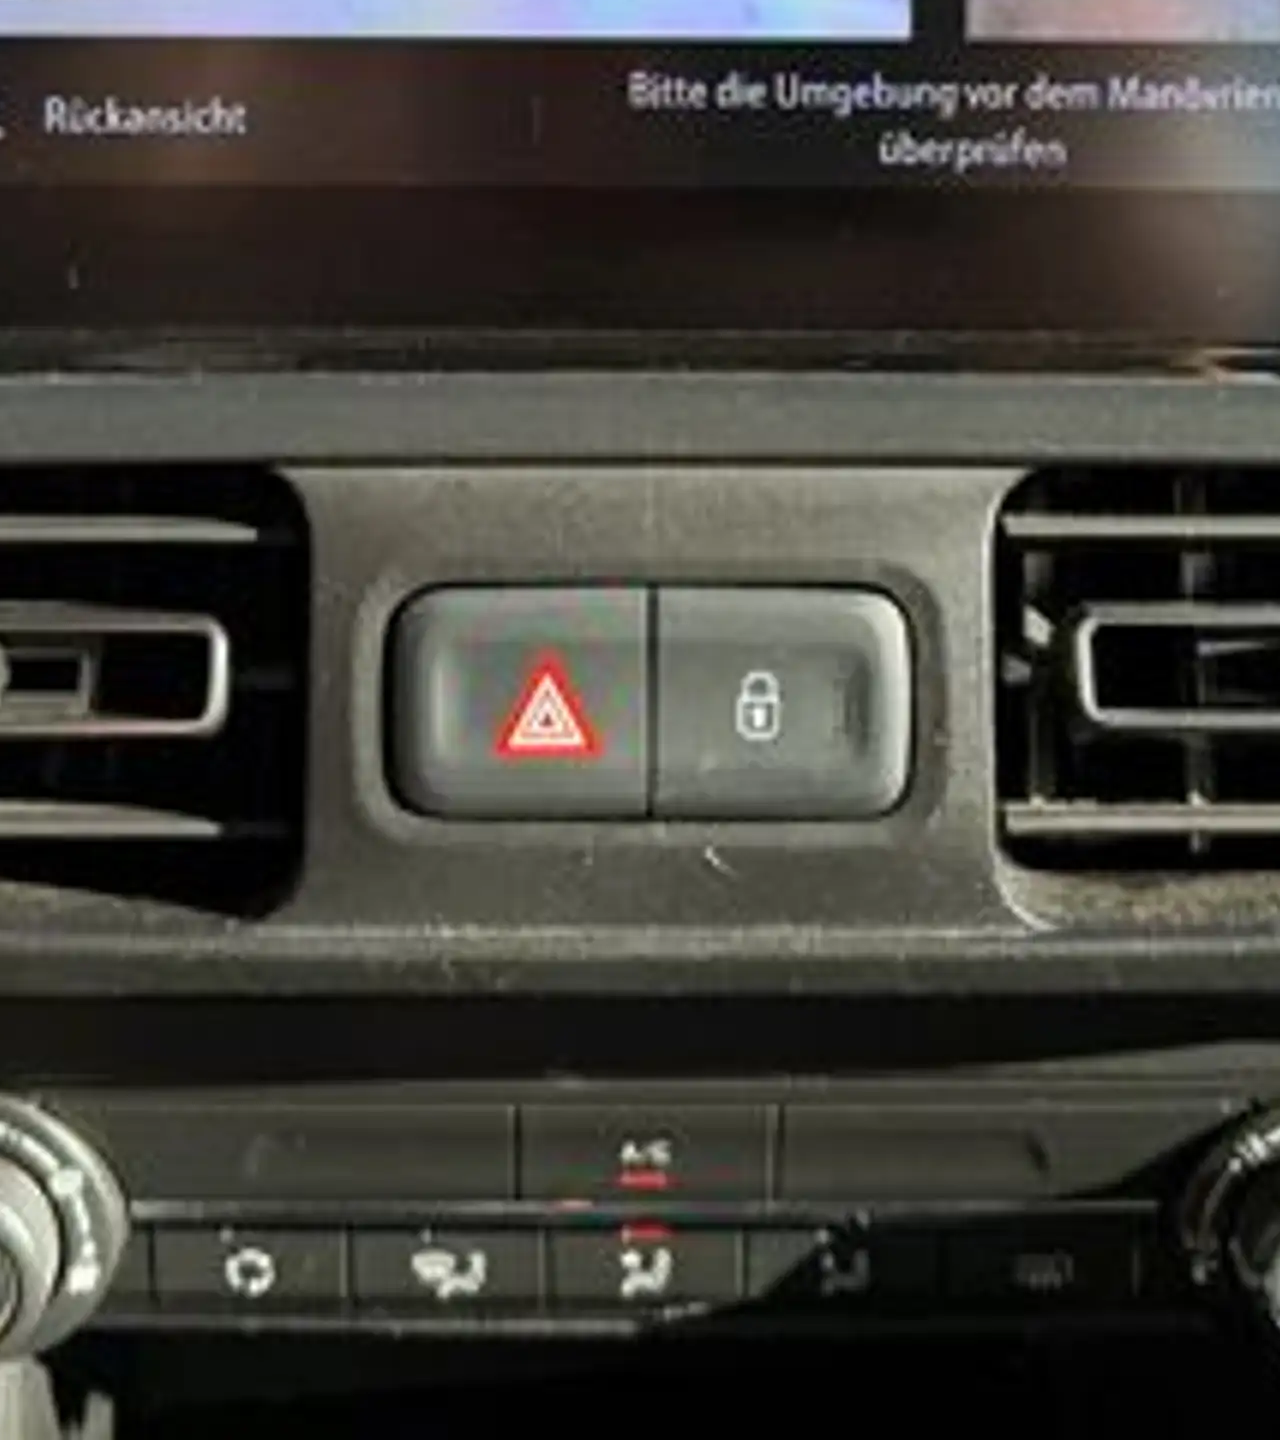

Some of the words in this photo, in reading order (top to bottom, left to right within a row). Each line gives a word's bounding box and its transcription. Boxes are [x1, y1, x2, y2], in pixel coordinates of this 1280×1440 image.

[44, 94, 247, 135] Rückansicht
[627, 70, 707, 109] Bitte
[716, 71, 767, 109] die
[776, 71, 959, 117] Umgebung
[963, 82, 1019, 109] vor
[1024, 73, 1100, 109] dem
[878, 127, 1068, 172] überprüfen
